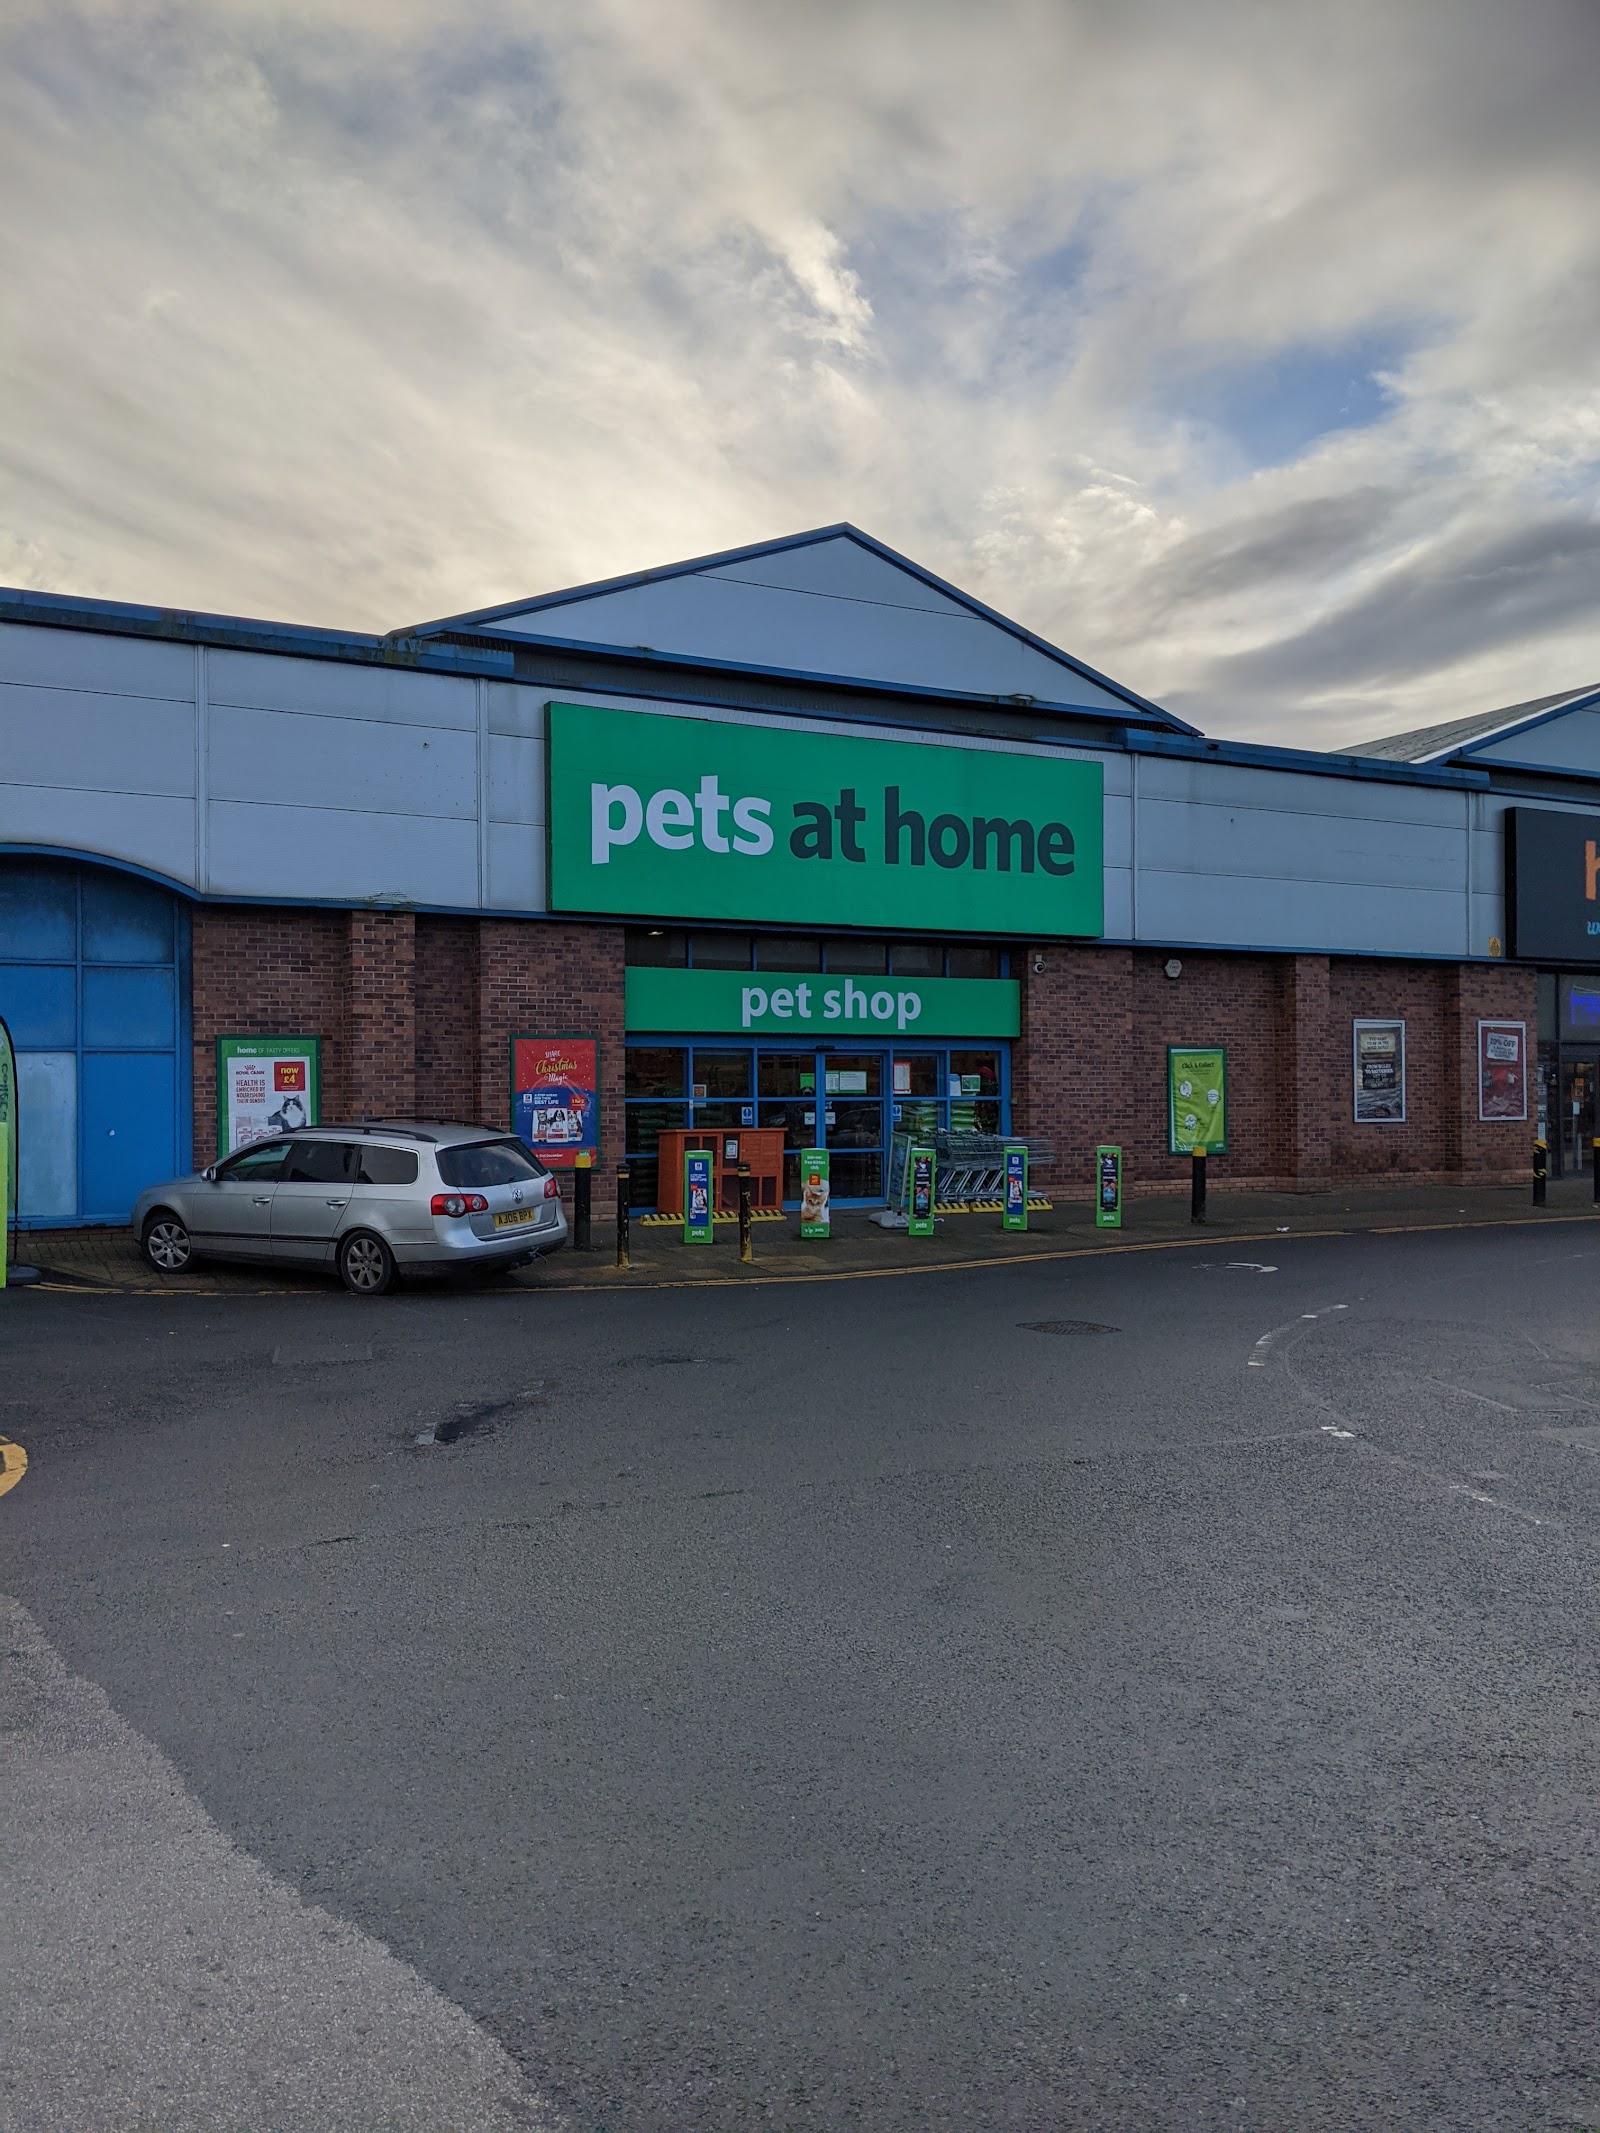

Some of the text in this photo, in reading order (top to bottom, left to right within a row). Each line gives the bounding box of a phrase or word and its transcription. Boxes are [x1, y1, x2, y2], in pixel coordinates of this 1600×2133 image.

[591, 775, 1076, 876] pets at home
[742, 979, 922, 1030] pet shop
[1503, 1039, 1516, 1048] OFF
[237, 1046, 257, 1054] home
[280, 1067, 299, 1075] now
[534, 1057, 578, 1075] Christmas
[283, 1074, 296, 1084] £4
[544, 1073, 569, 1085] Magic
